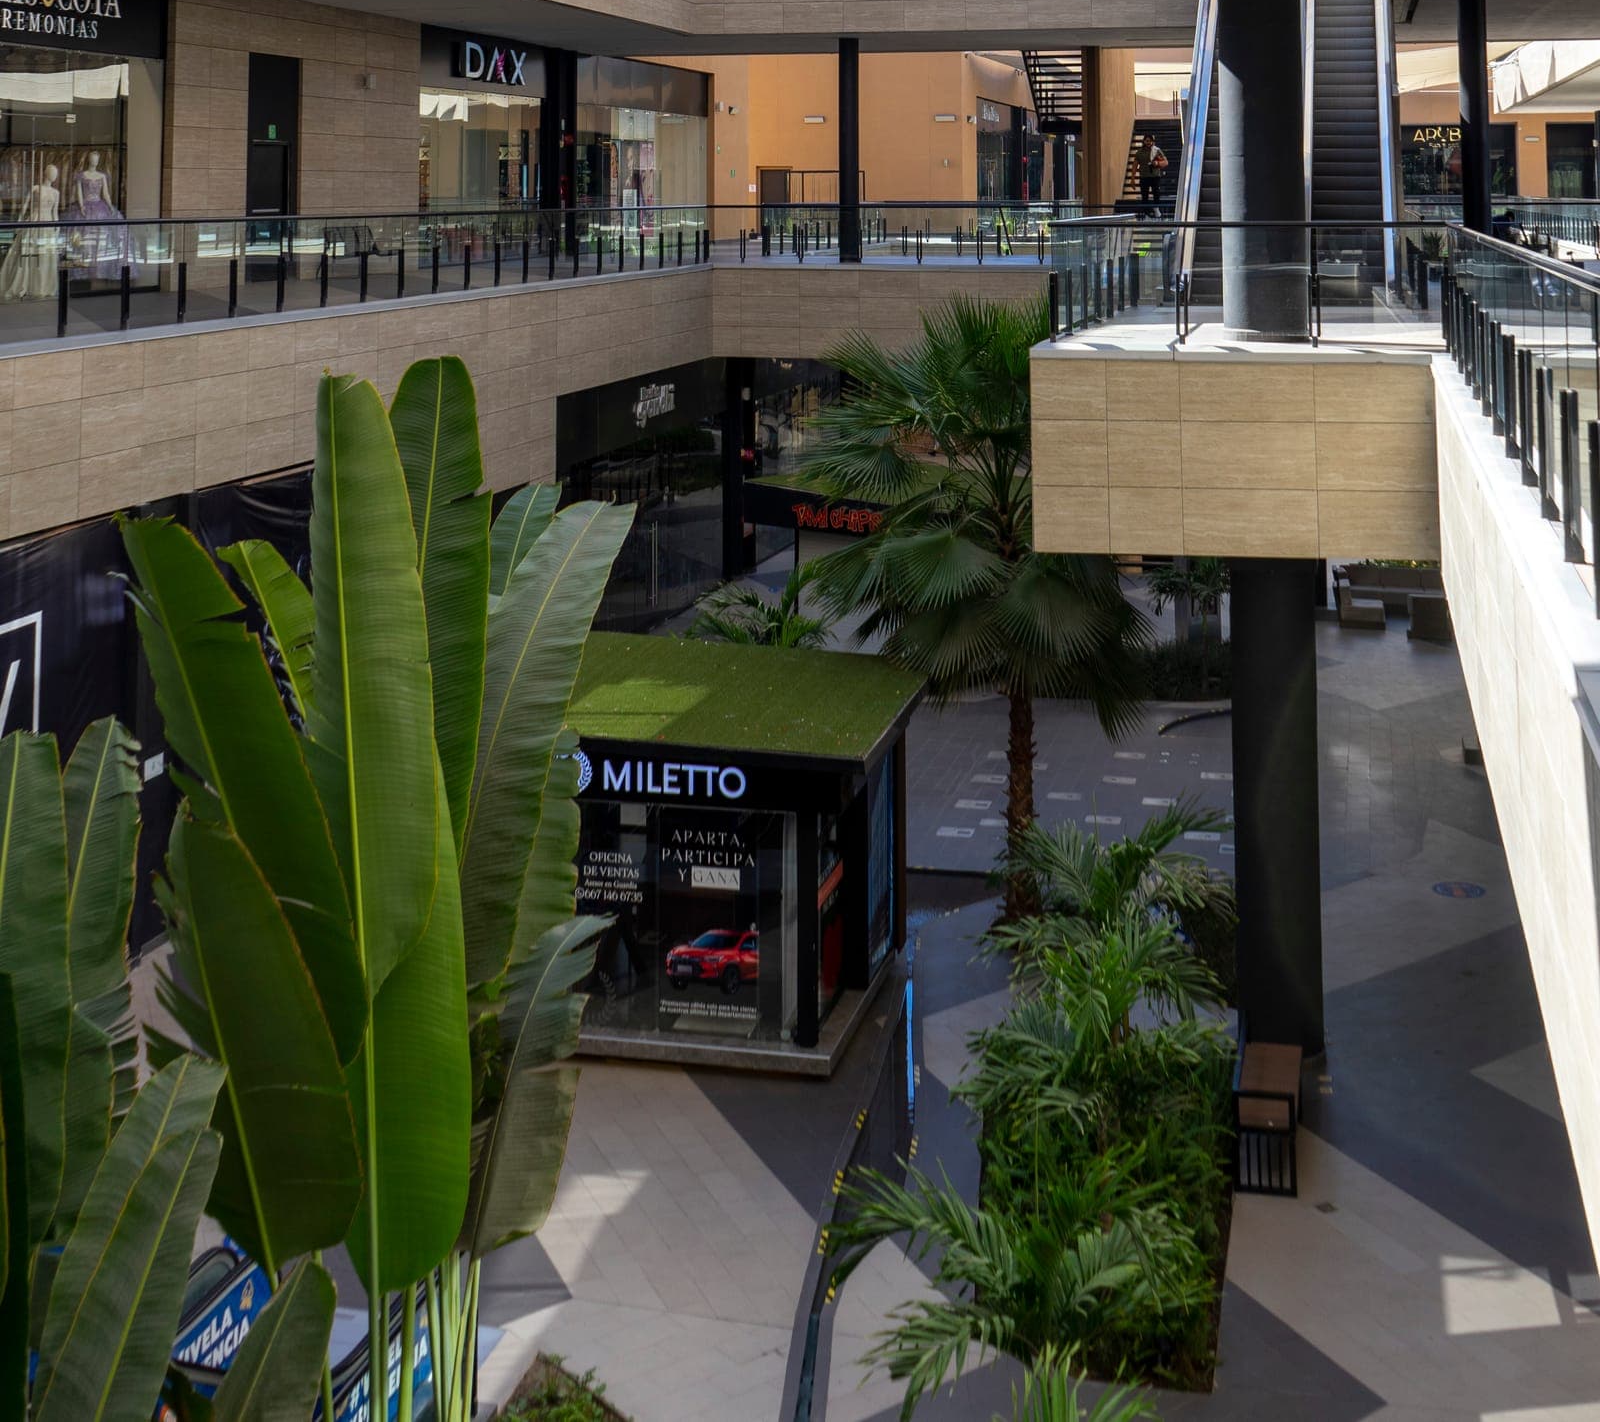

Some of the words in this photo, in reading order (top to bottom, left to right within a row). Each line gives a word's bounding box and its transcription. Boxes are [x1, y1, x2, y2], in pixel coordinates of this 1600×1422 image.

[465, 41, 527, 86] DAX
[603, 759, 746, 799] MILETTO
[671, 828, 746, 848] APARTA,
[589, 851, 632, 864] OFICINA
[662, 847, 756, 868] PARTICIPA
[583, 865, 598, 877] DE
[599, 866, 640, 879] VENTAS
[678, 868, 687, 883] Y
[693, 868, 739, 886] GANA
